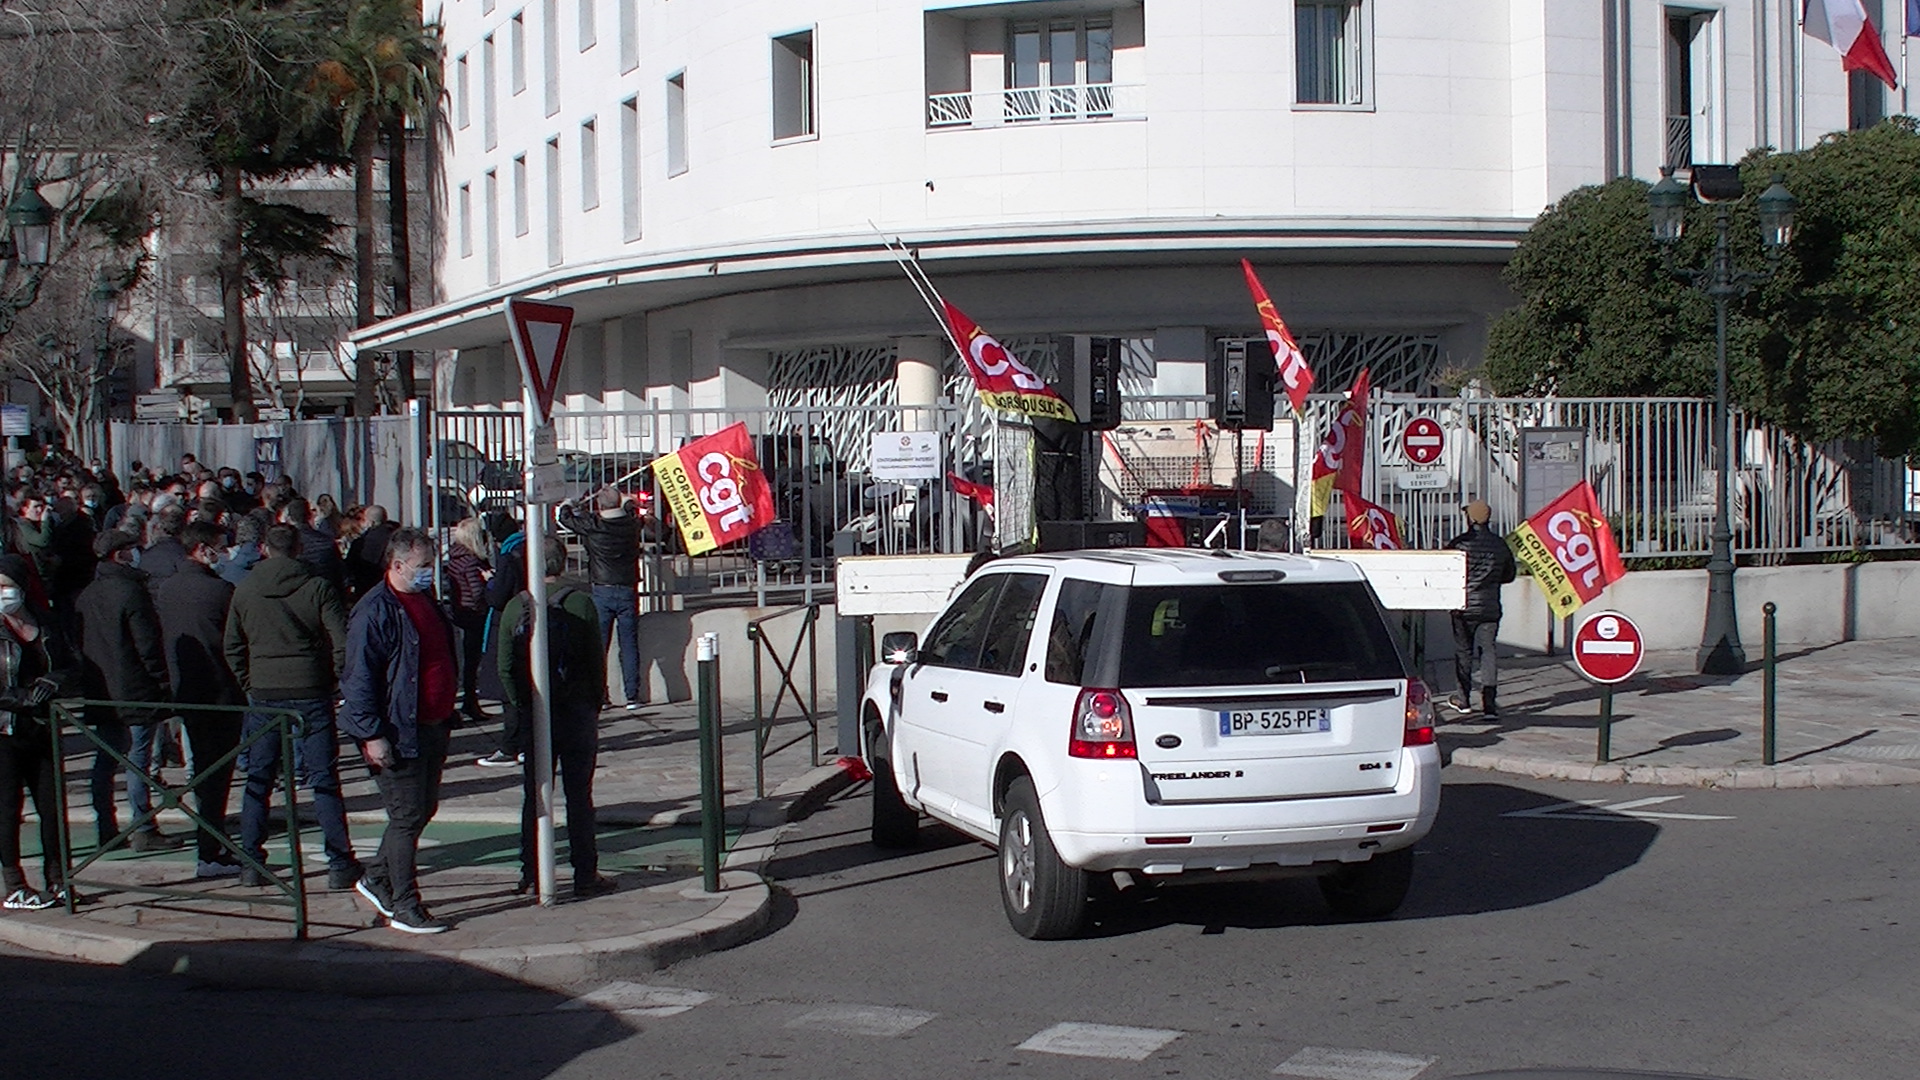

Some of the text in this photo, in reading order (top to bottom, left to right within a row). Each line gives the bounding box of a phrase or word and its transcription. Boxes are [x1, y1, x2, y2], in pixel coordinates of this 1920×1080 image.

[659, 467, 676, 495] TUTTI
[672, 467, 701, 520] CORSICA
[697, 452, 755, 533] cgt
[1512, 536, 1559, 596] TUTTI INSEME
[1525, 533, 1565, 584] CORSICA
[1151, 771, 1231, 781] FREELANDER
